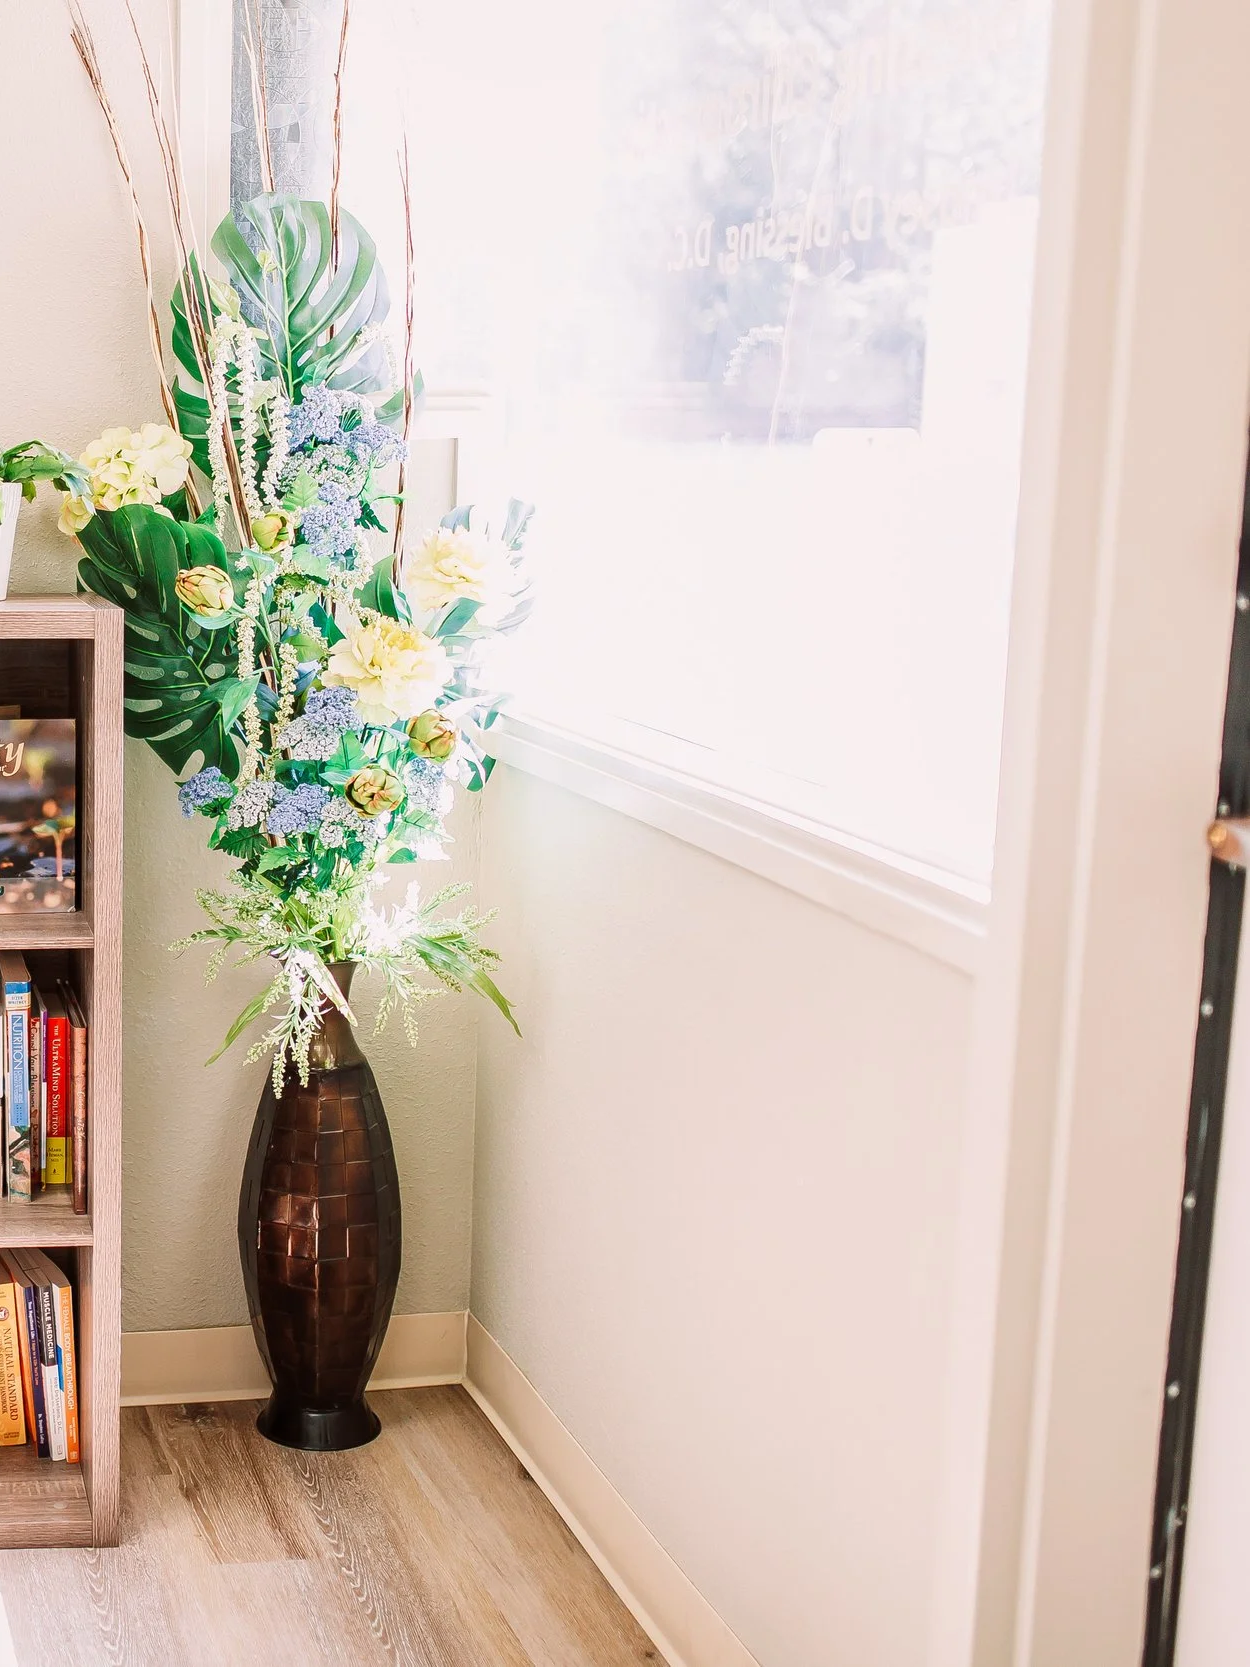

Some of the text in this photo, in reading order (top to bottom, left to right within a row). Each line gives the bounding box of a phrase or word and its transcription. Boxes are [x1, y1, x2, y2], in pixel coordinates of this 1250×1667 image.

[12, 1015, 23, 1070] NUTRITION
[30, 1027, 38, 1052] Count
[30, 1054, 38, 1071] Your
[51, 1094, 60, 1136] SOLUTION
[2, 1327, 14, 1368] NATURAL
[43, 1291, 55, 1359] MUSCLE MEDICINE
[7, 1373, 19, 1421] STANDARD
[64, 1353, 75, 1410] BREAKTHROUGH
